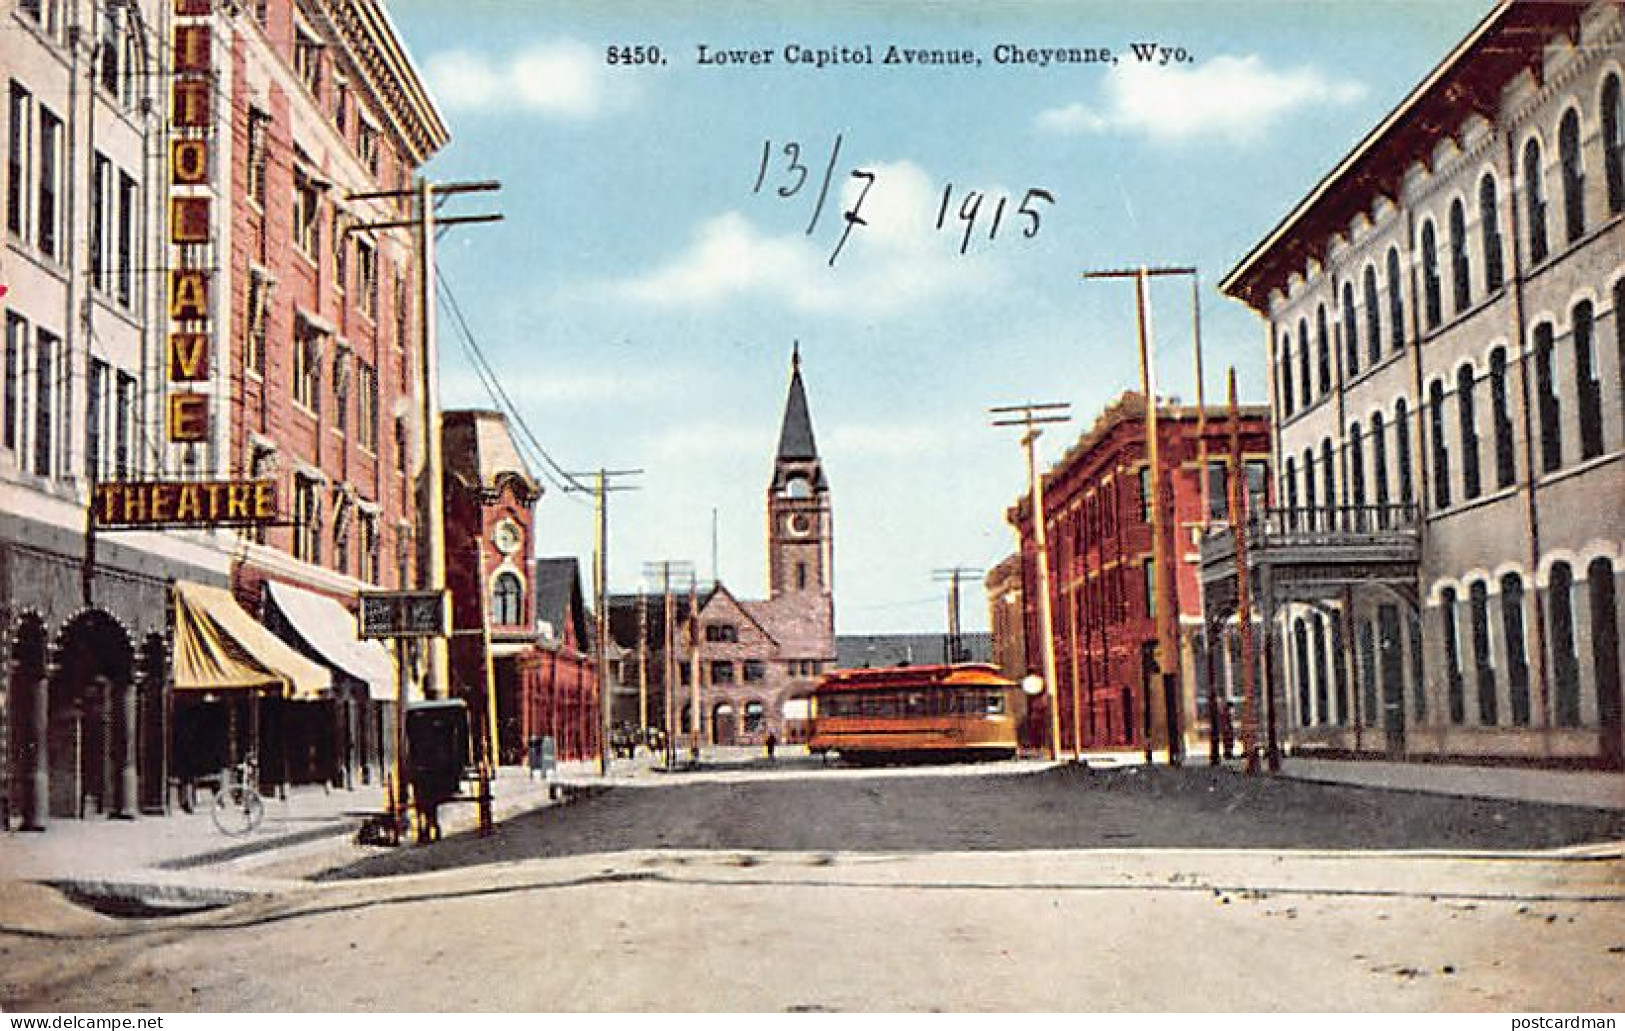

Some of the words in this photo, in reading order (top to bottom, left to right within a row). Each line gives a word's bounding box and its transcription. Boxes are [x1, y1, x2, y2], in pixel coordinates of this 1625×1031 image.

[936, 183, 1055, 254] 1915
[173, 272, 207, 439] AVE
[97, 481, 274, 522] THEATRE
